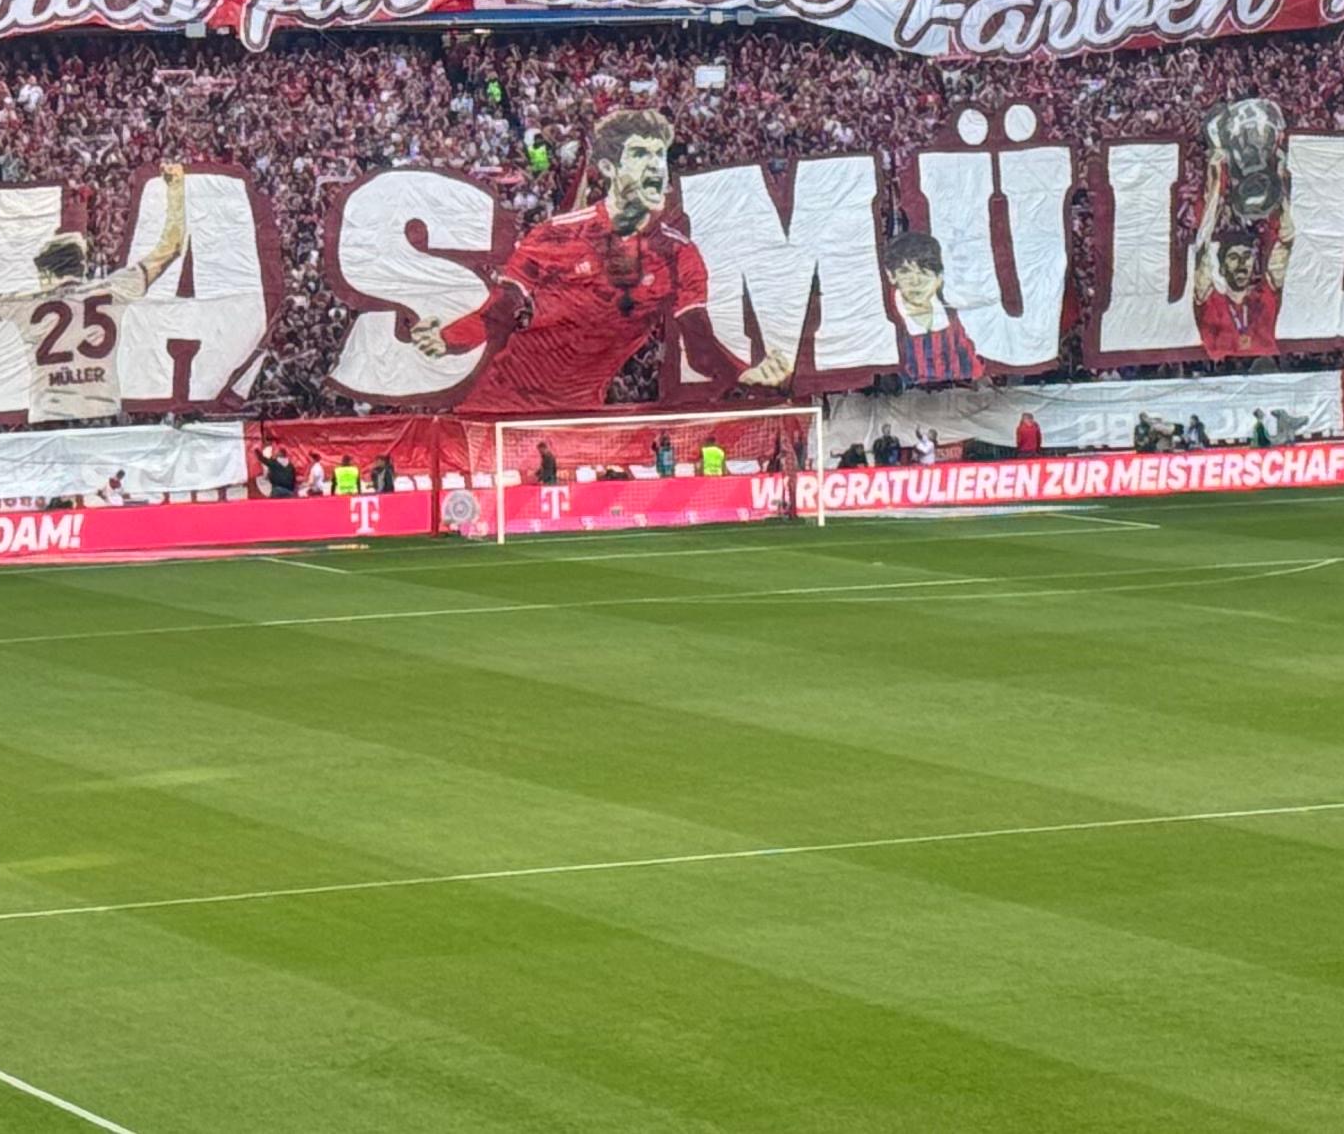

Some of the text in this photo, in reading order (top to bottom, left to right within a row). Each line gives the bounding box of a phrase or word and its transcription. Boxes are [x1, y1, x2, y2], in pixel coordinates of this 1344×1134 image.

[30, 293, 117, 366] 25
[49, 366, 106, 386] MÜLLER
[751, 473, 819, 510] WIR
[823, 463, 1041, 509] GRATULIEREN
[1044, 458, 1107, 496] ZUR
